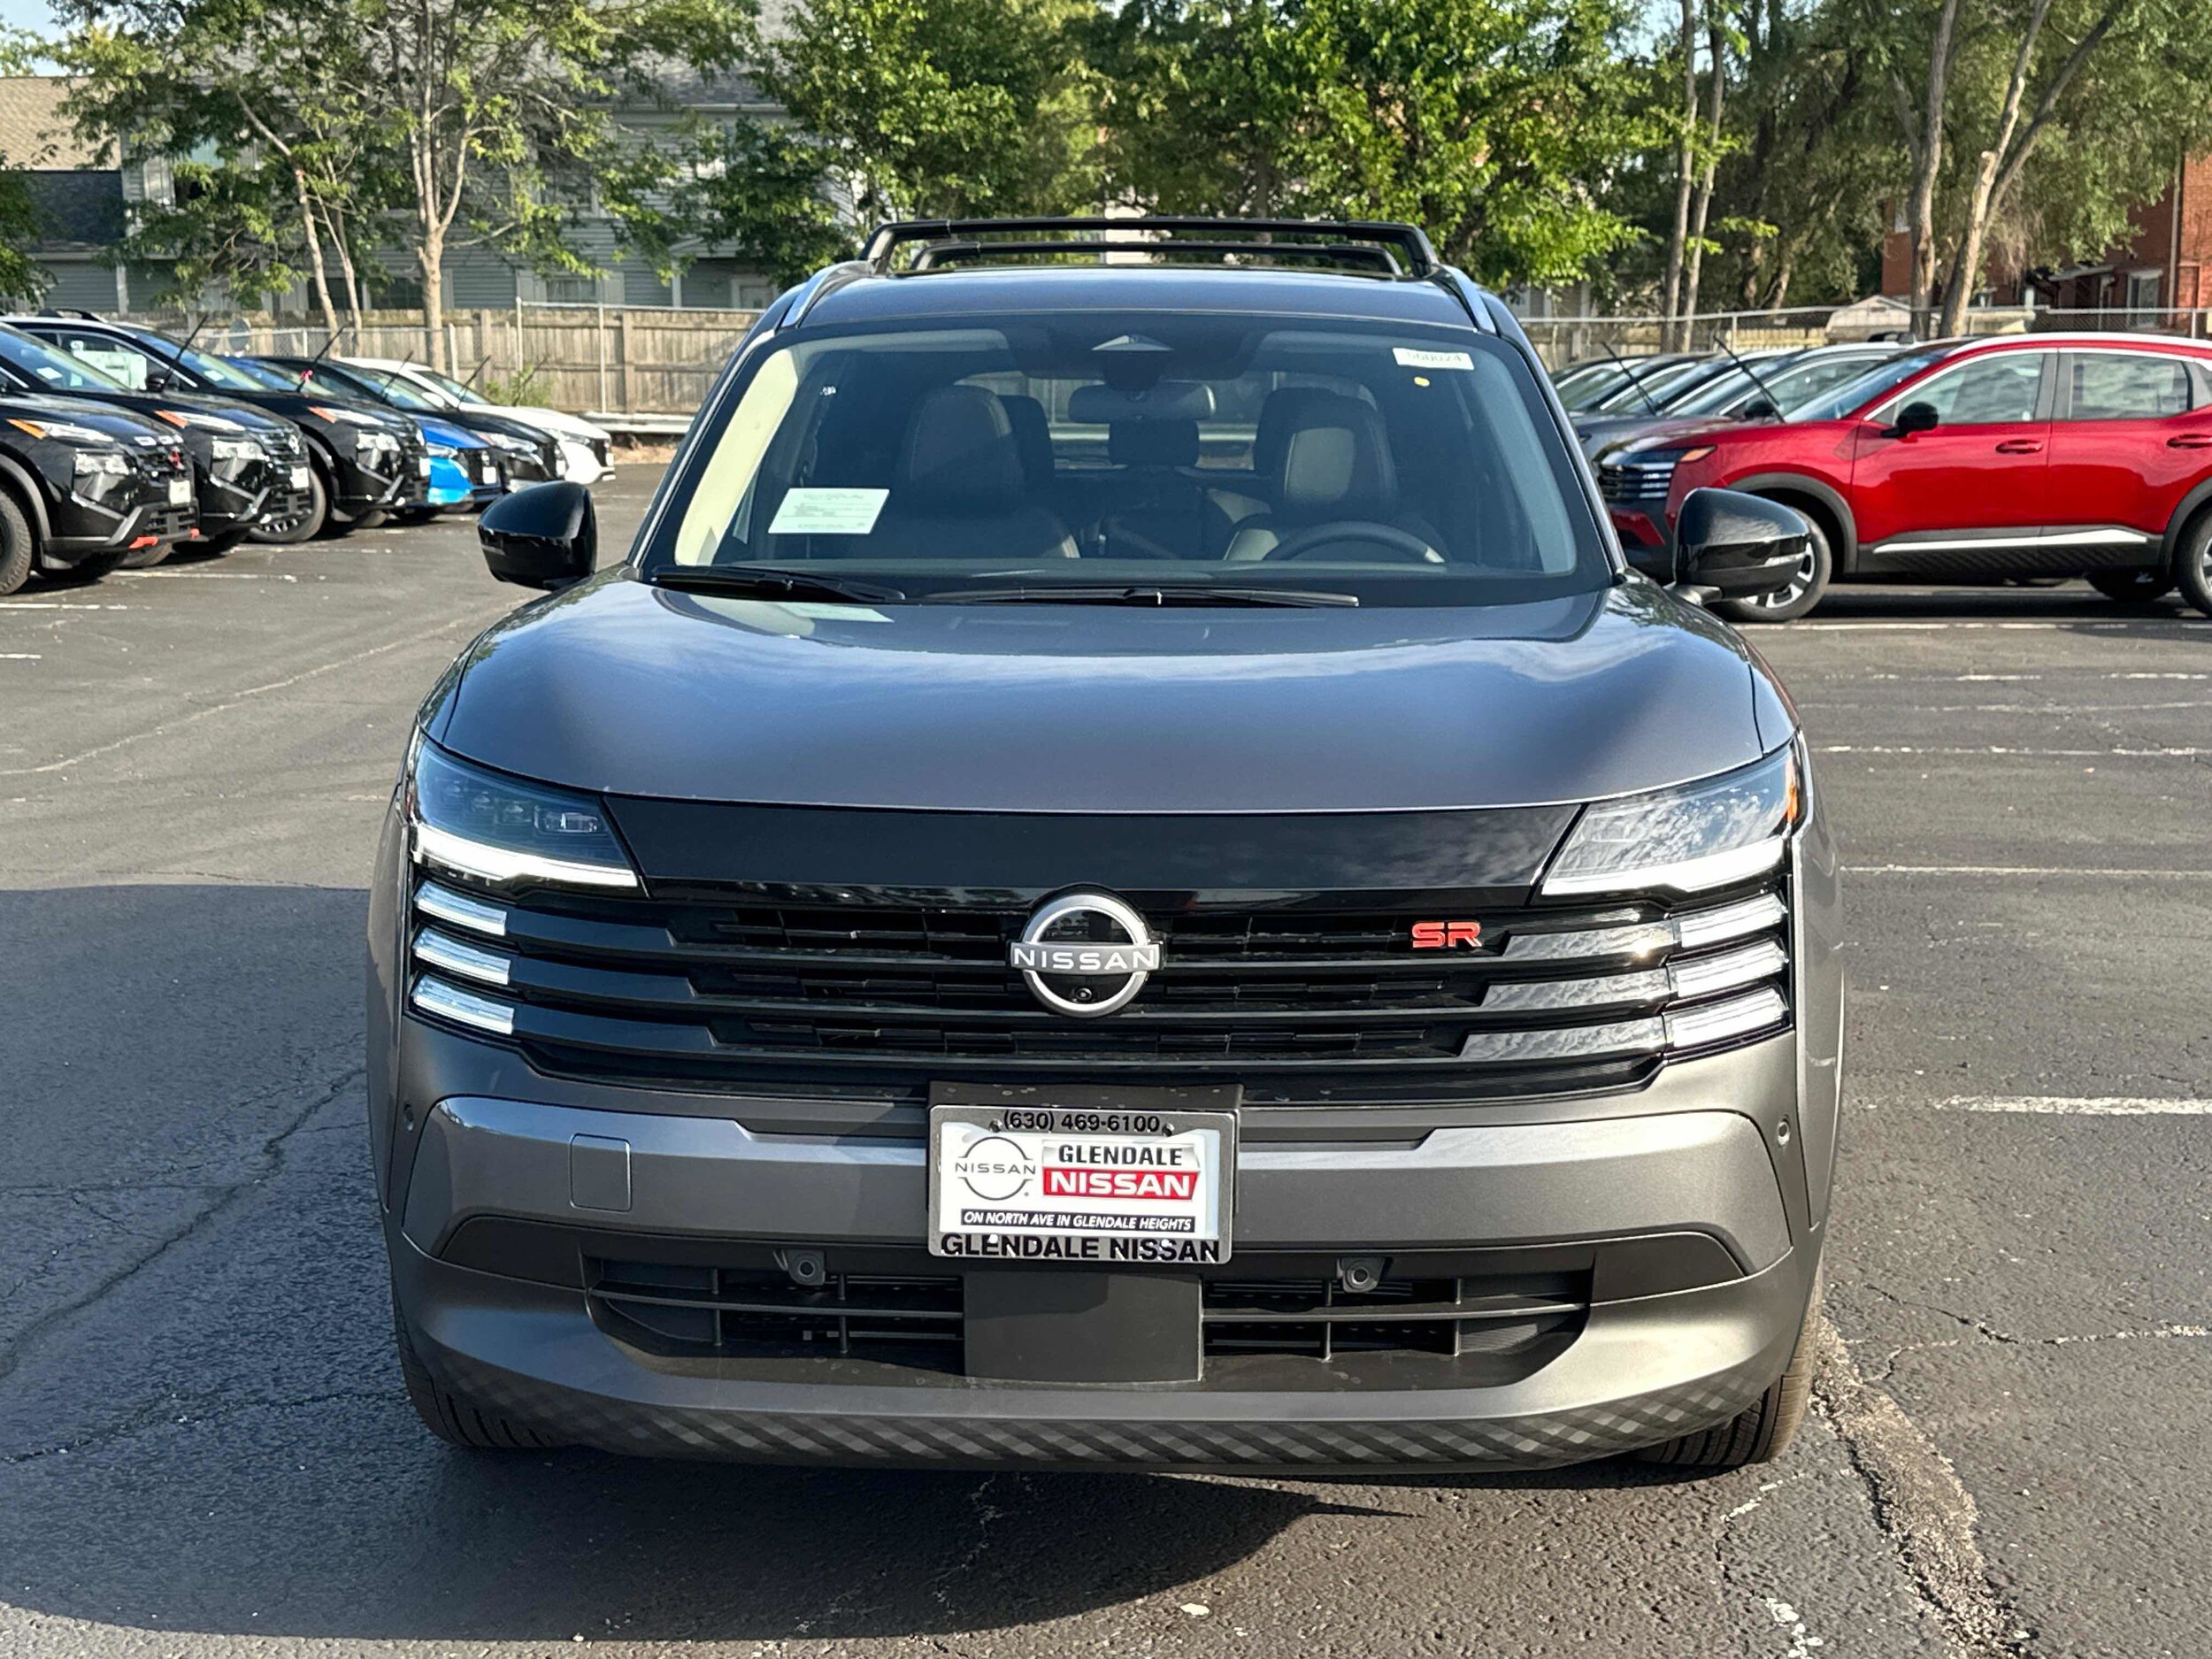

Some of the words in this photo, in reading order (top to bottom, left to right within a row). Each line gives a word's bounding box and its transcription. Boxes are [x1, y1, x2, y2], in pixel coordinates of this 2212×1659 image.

[1411, 922, 1482, 948] SR
[1014, 948, 1154, 971] NISSAN
[1004, 1110, 1054, 1132] (630)
[1061, 1114, 1160, 1133] 469-6100
[1058, 1144, 1182, 1166] GLENDALE
[955, 1162, 1036, 1175] NISSAN
[1050, 1171, 1190, 1197] NISSAN
[964, 1210, 984, 1224] ON
[986, 1212, 1028, 1225] NORTH
[1030, 1214, 1055, 1226] AVE
[1056, 1215, 1071, 1227] IN
[1072, 1215, 1137, 1229] GLENDALE
[1139, 1217, 1192, 1231] HEIGHTS
[941, 1233, 1099, 1259] GLENDALE
[1110, 1238, 1220, 1263] NISSAN
